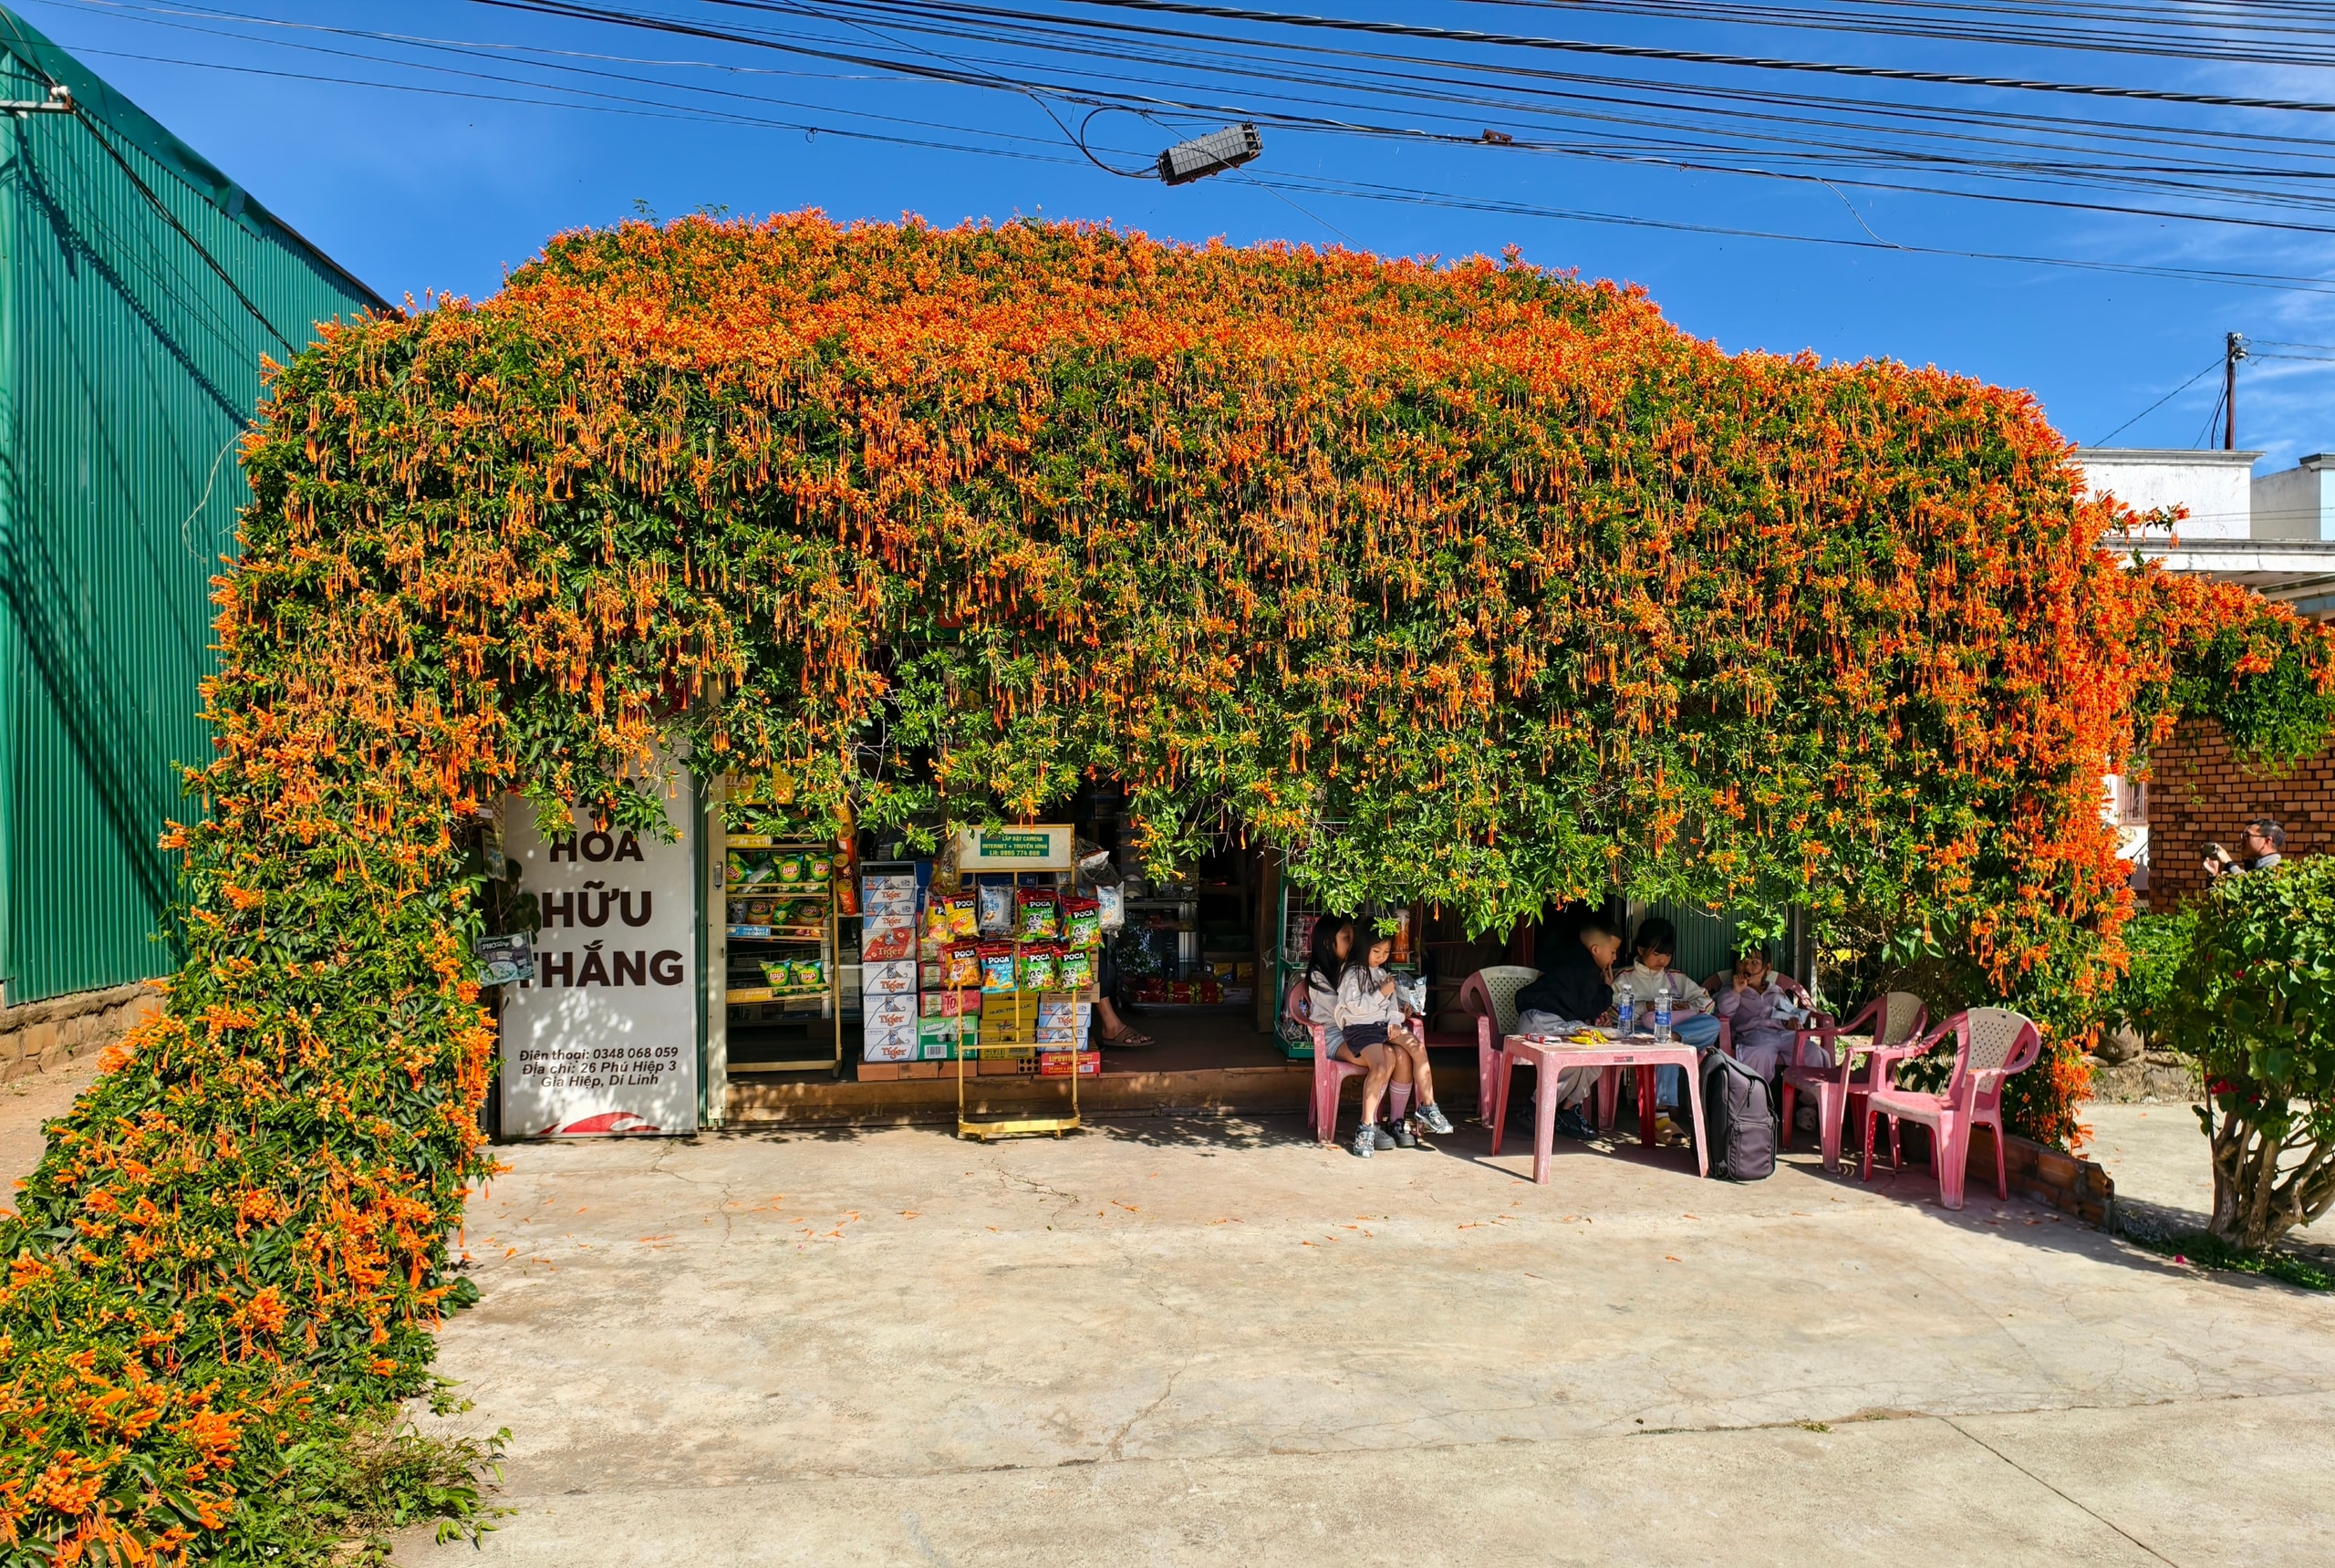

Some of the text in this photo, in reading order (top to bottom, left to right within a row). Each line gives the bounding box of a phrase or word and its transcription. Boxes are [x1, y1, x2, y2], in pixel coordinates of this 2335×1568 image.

[881, 890, 902, 900] Tiger
[542, 880, 652, 929] HỮU
[955, 900, 974, 909] POCA
[1074, 909, 1095, 919] POCA
[881, 917, 903, 927] Tiger
[877, 946, 903, 959] Tiger
[954, 950, 975, 959] POCA
[1030, 954, 1051, 962] POCA
[1064, 952, 1084, 961] POCA
[520, 940, 684, 989] HẮNG
[988, 956, 1010, 964] POCA
[880, 981, 906, 992] Tiger
[878, 1014, 905, 1026] Tiger
[552, 1048, 590, 1064] thoại:
[593, 1047, 625, 1060] 0348
[628, 1047, 652, 1059] 068
[654, 1046, 679, 1058] 059
[881, 1047, 907, 1059] Tiger
[522, 1063, 545, 1077] Địa
[580, 1062, 597, 1074] 26
[600, 1061, 628, 1073] Phú
[632, 1061, 665, 1075] Hiệp
[668, 1060, 677, 1071] 3
[541, 1074, 659, 1089] Gia Hiệp, Di Linh
